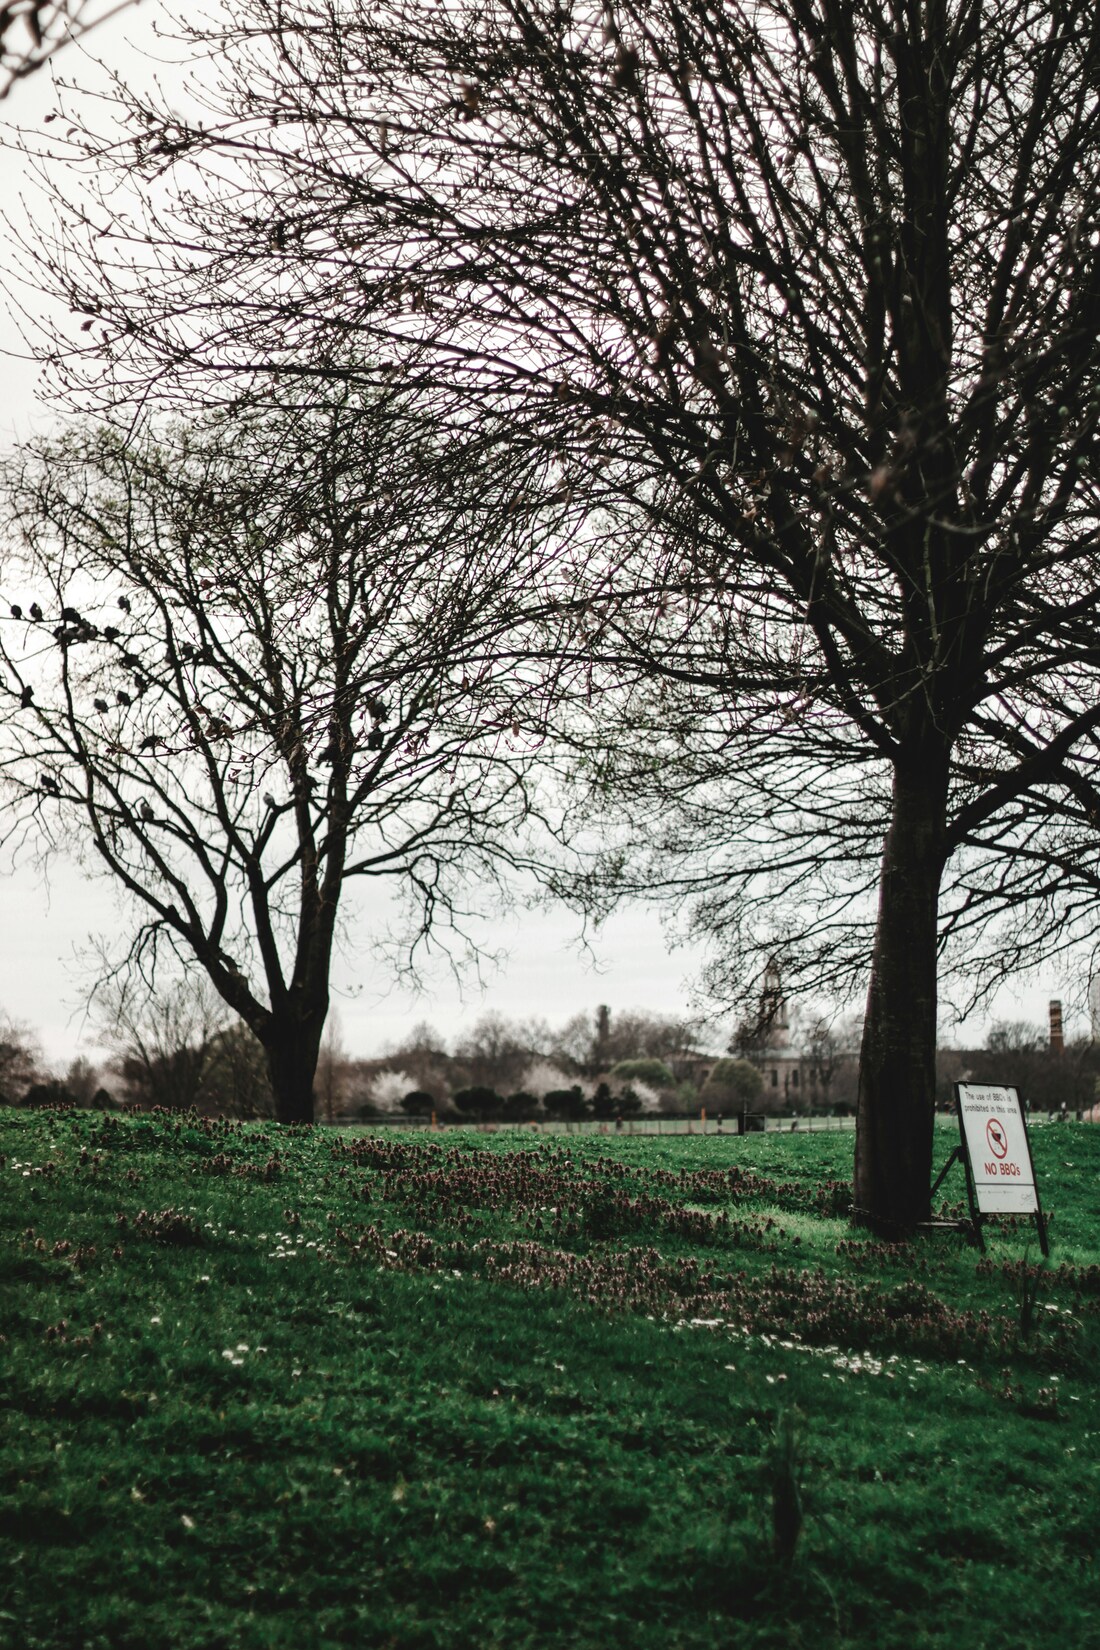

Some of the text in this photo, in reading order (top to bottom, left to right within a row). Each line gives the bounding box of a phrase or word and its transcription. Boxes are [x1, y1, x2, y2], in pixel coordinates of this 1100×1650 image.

[965, 1091, 974, 1100] The
[986, 1093, 991, 1101] of
[1007, 1094, 1012, 1102] is
[964, 1104, 989, 1112] prohibited
[996, 1105, 1006, 1113] this
[984, 1162, 1021, 1176] NO BBQ's
